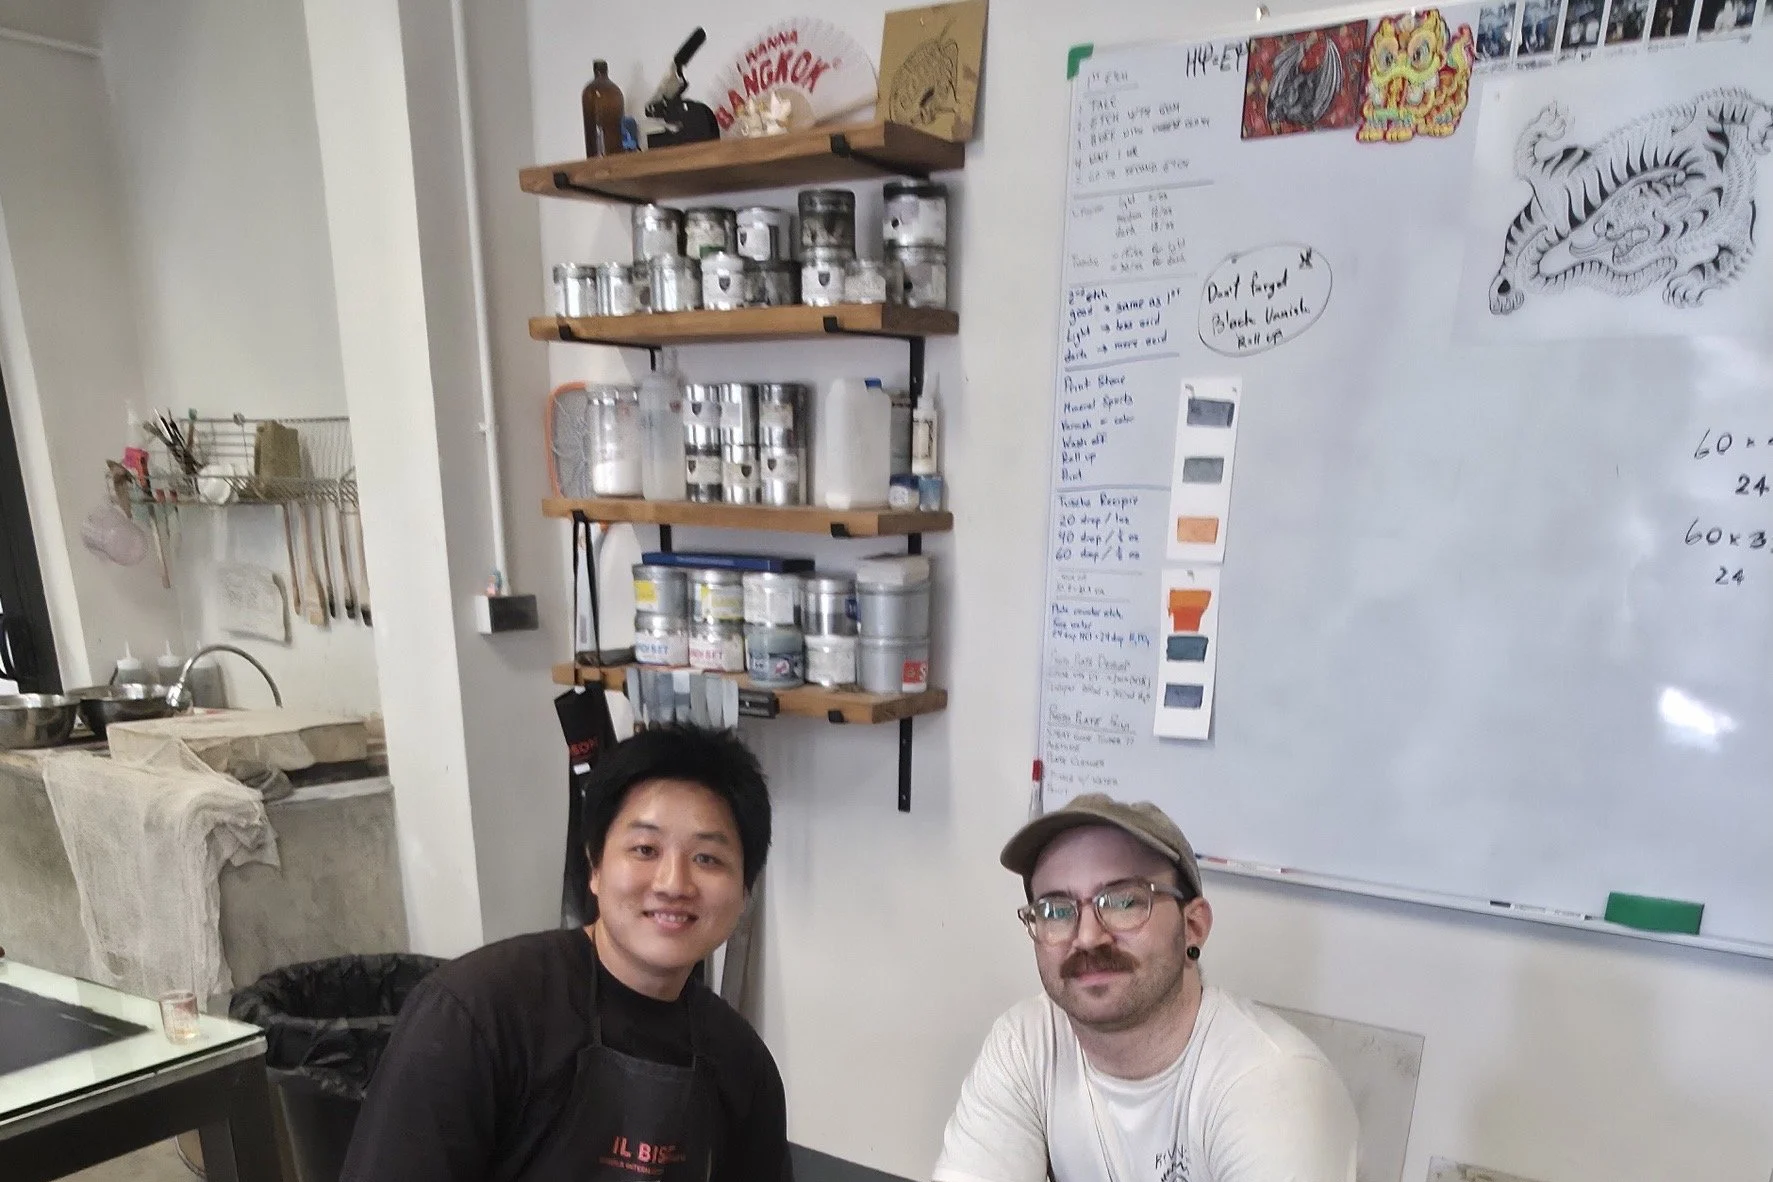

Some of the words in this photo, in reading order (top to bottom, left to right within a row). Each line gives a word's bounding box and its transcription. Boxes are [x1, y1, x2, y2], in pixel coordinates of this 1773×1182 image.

[715, 50, 830, 131] BANGKOK
[1208, 273, 1240, 304] Don't
[1212, 307, 1256, 337] Black
[1693, 427, 1733, 460] 60
[1735, 472, 1770, 498] 24
[1058, 529, 1075, 545] 40
[1684, 516, 1724, 546] 60
[612, 1135, 632, 1159] IL
